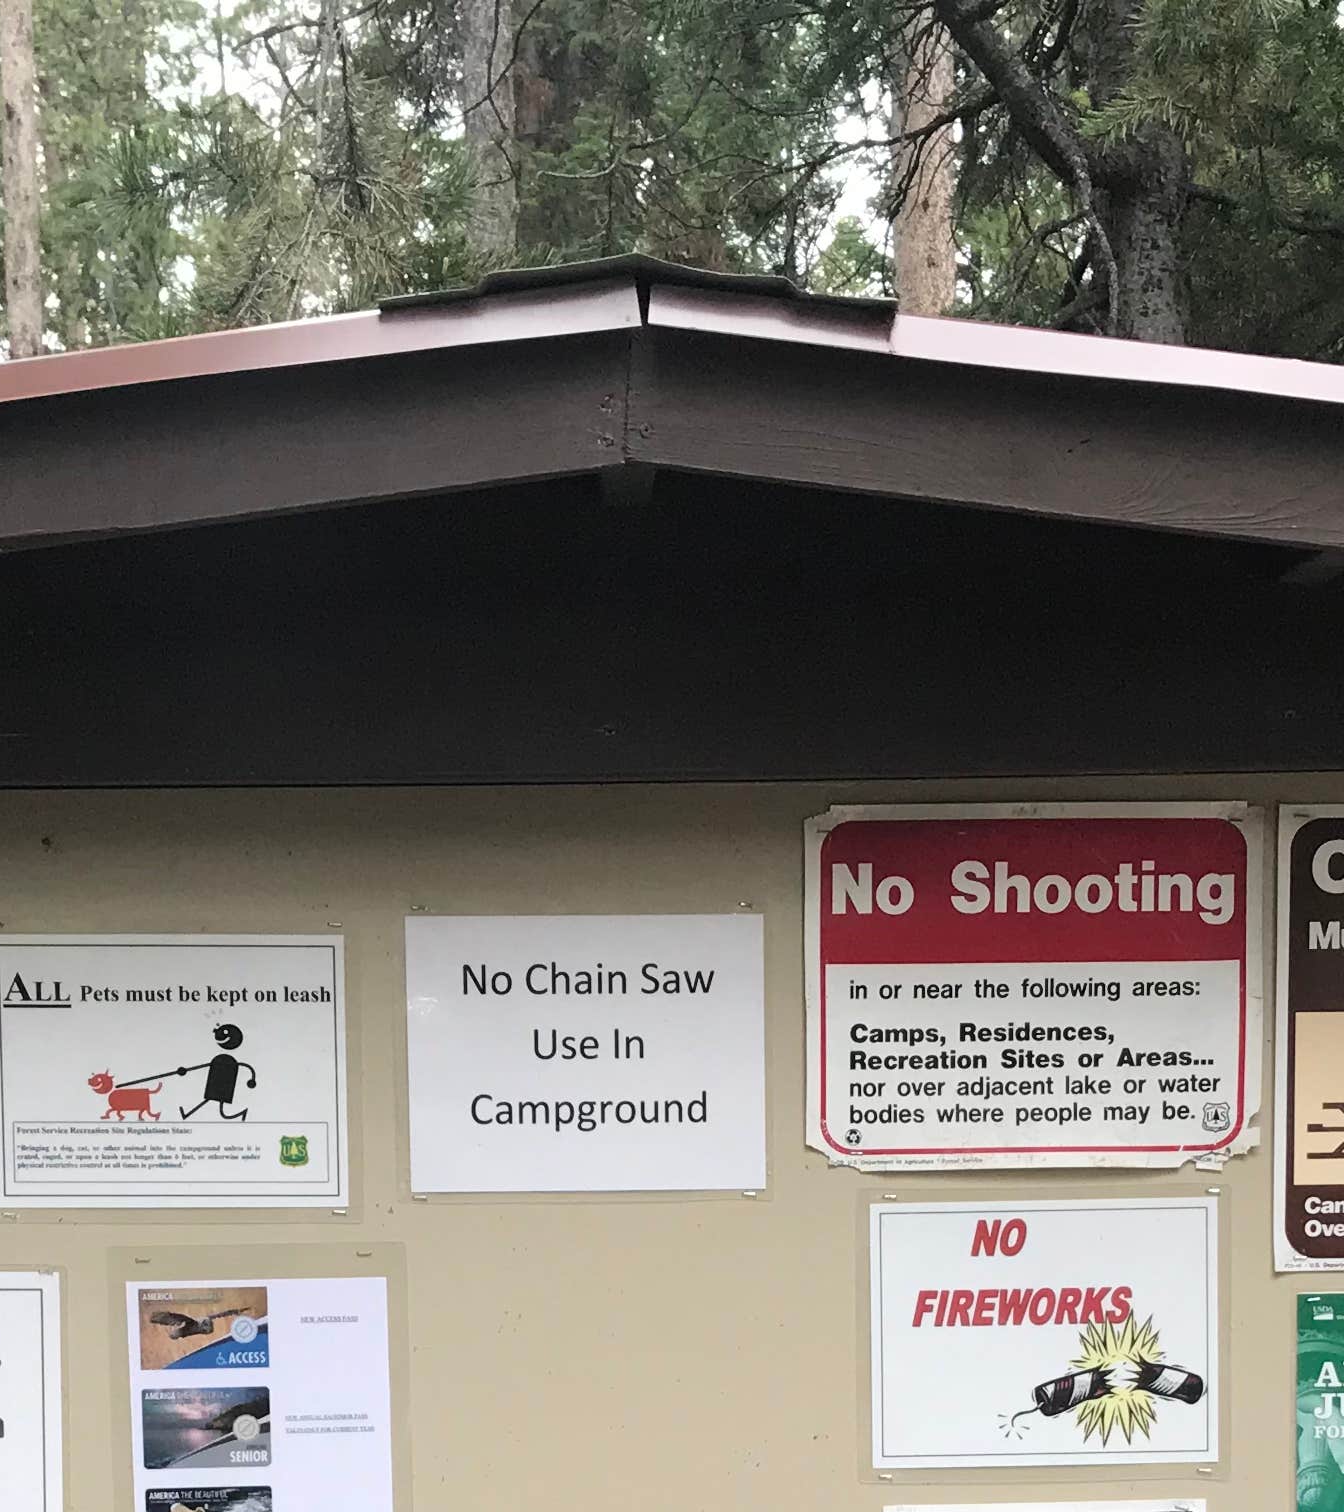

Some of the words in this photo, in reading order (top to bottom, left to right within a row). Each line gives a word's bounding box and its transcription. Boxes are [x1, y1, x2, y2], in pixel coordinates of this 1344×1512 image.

[831, 863, 914, 915] No
[950, 860, 1234, 924] Shooting
[3, 972, 70, 1001] ALL
[462, 964, 512, 995] No
[525, 961, 626, 994] Chain
[640, 963, 714, 994] Saw
[849, 979, 867, 999] in
[878, 984, 902, 999] or
[913, 983, 962, 998] near
[973, 978, 1009, 998] the
[1020, 977, 1120, 1001] following
[1132, 981, 1200, 996] areas:
[80, 985, 118, 1001] Pets
[126, 987, 172, 1001] must
[178, 985, 200, 1001] be
[206, 985, 248, 1006] kept
[254, 990, 276, 1002] on
[284, 983, 331, 1002] leash
[533, 1029, 599, 1059] Use
[614, 1028, 644, 1058] In
[849, 1023, 945, 1046] Camps,
[959, 1022, 1114, 1044] Residences,
[849, 1049, 986, 1070] Recreation
[1000, 1048, 1064, 1068] Sites
[1077, 1053, 1104, 1067] or
[1116, 1047, 1214, 1066] Areas...
[849, 1082, 886, 1097] nor
[896, 1081, 945, 1096] over
[956, 1076, 1053, 1099] adjacent
[1065, 1075, 1111, 1094] lake
[1123, 1079, 1146, 1094] or
[1157, 1074, 1220, 1092] water
[470, 1090, 706, 1131] Campground
[849, 1103, 924, 1124] bodies
[936, 1103, 1004, 1122] where
[1015, 1101, 1092, 1126] people
[1103, 1105, 1150, 1124] may
[1162, 1100, 1195, 1120] be.
[970, 1218, 1026, 1256] NO
[912, 1286, 1133, 1327] FIREWORKS
[228, 1352, 266, 1364] ACCESS
[230, 1451, 268, 1462] SENIOR
